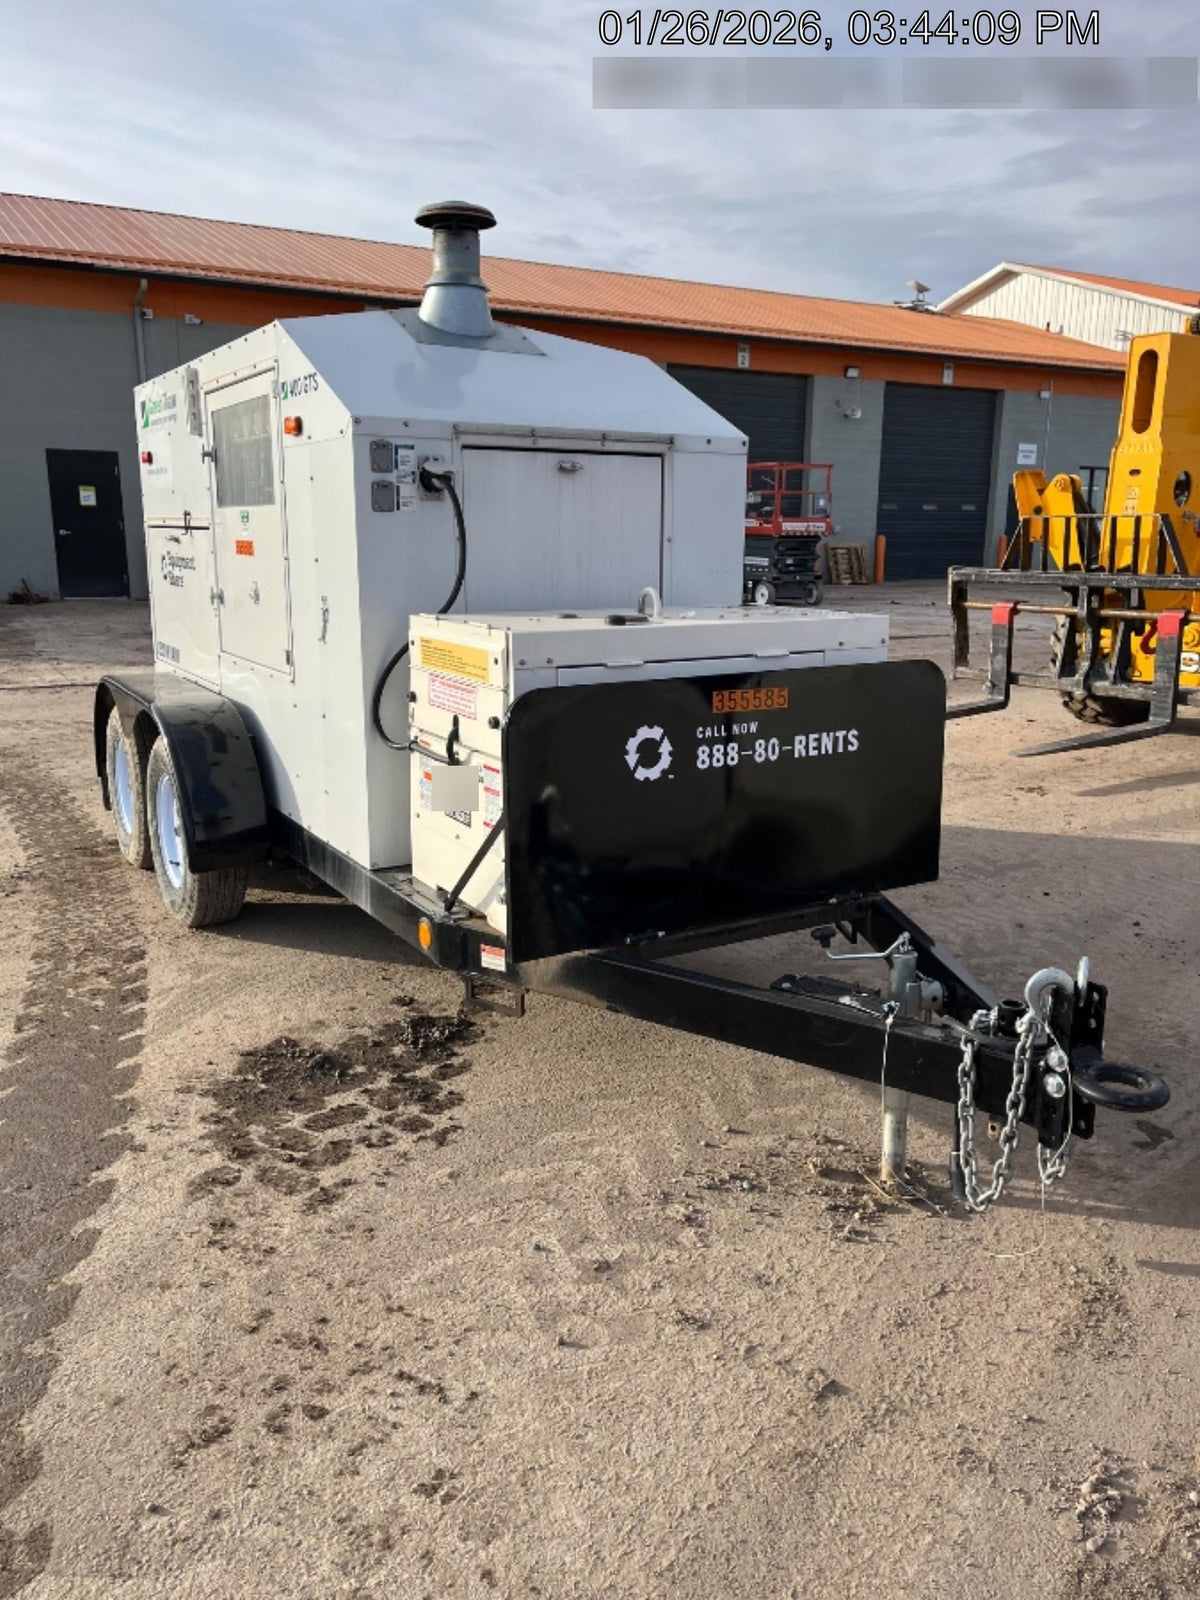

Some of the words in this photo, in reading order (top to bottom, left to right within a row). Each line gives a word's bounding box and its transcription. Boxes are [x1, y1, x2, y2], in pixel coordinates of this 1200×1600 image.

[714, 689, 788, 712] 355585
[696, 724, 728, 739] CALL
[732, 721, 759, 735] NOW
[696, 728, 860, 770] 888-80-RENTS
